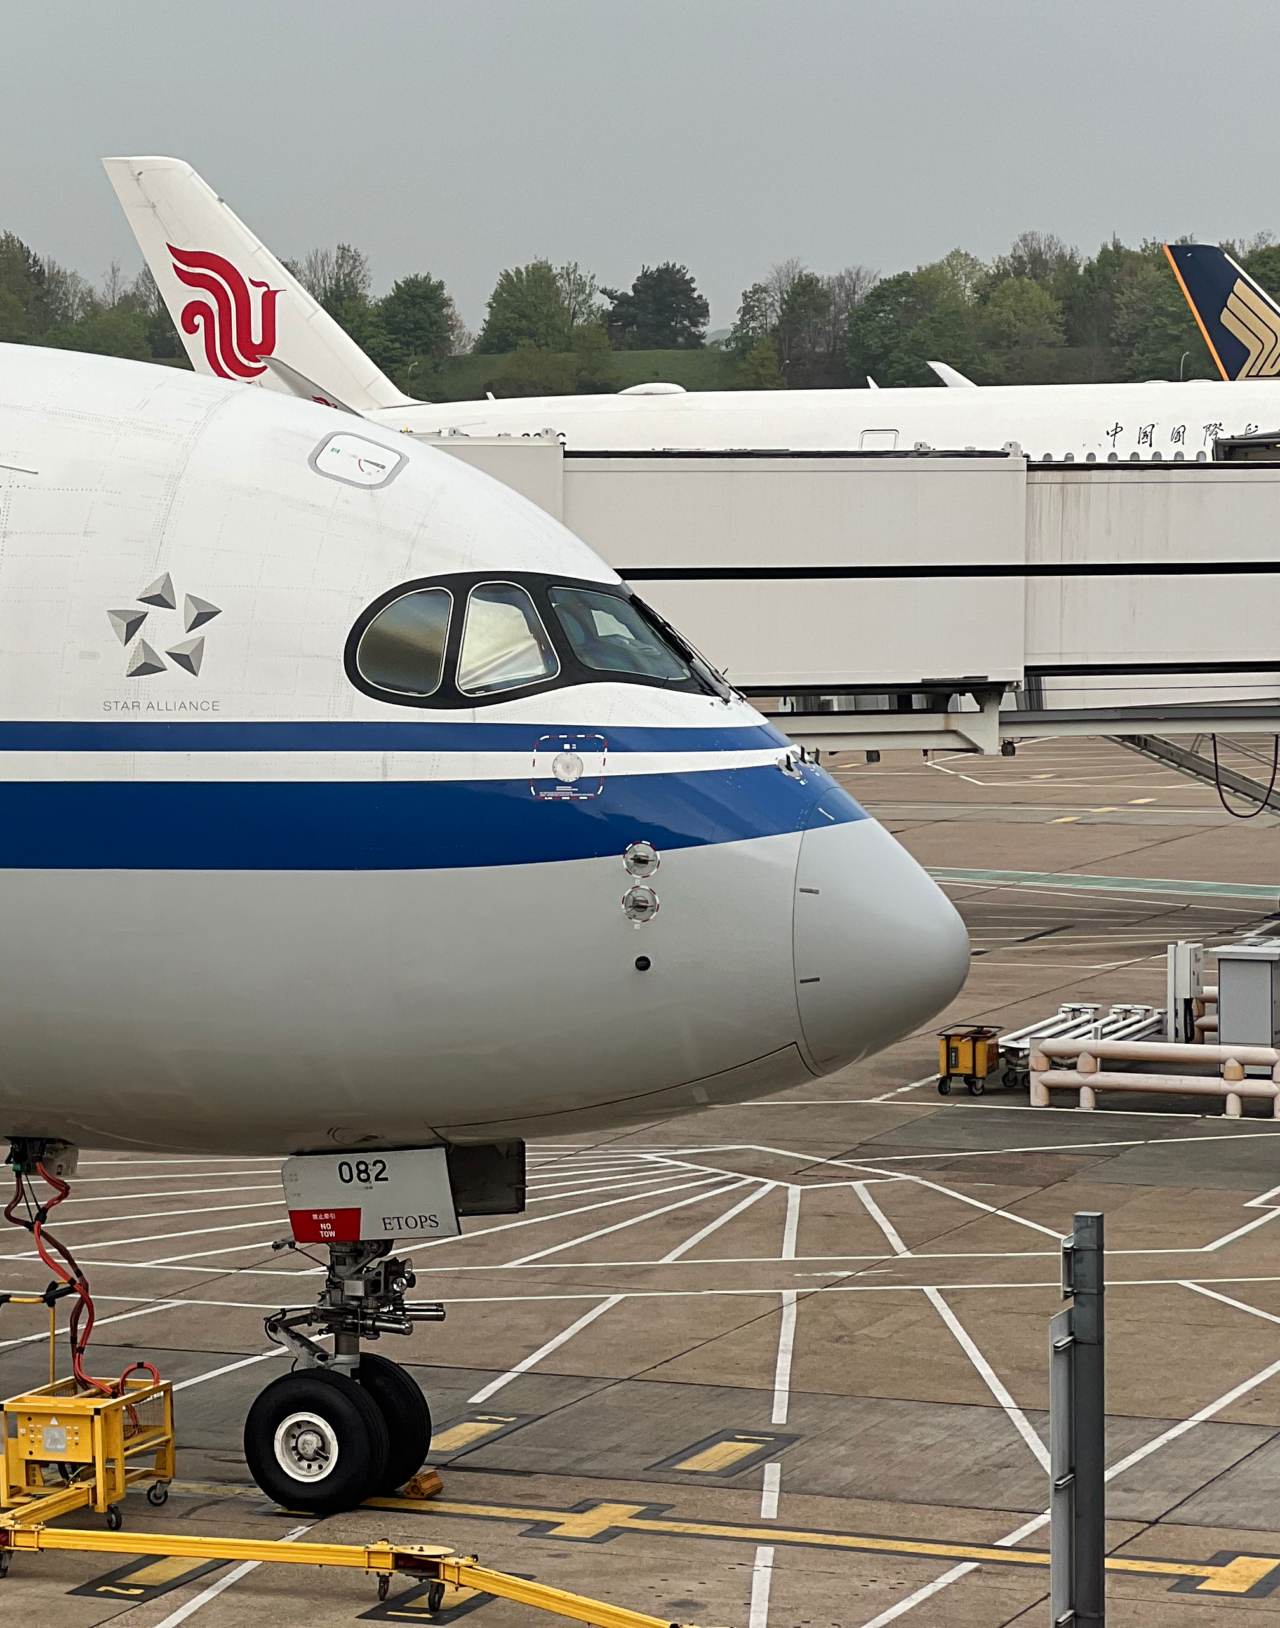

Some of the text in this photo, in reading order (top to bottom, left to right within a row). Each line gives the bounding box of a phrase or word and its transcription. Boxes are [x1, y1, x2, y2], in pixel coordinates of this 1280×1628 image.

[102, 700, 220, 712] STAR ALLIANCE
[337, 1159, 389, 1184] 082
[320, 1222, 332, 1230] NO
[381, 1214, 440, 1231] ETOPS
[319, 1230, 336, 1238] TOW
